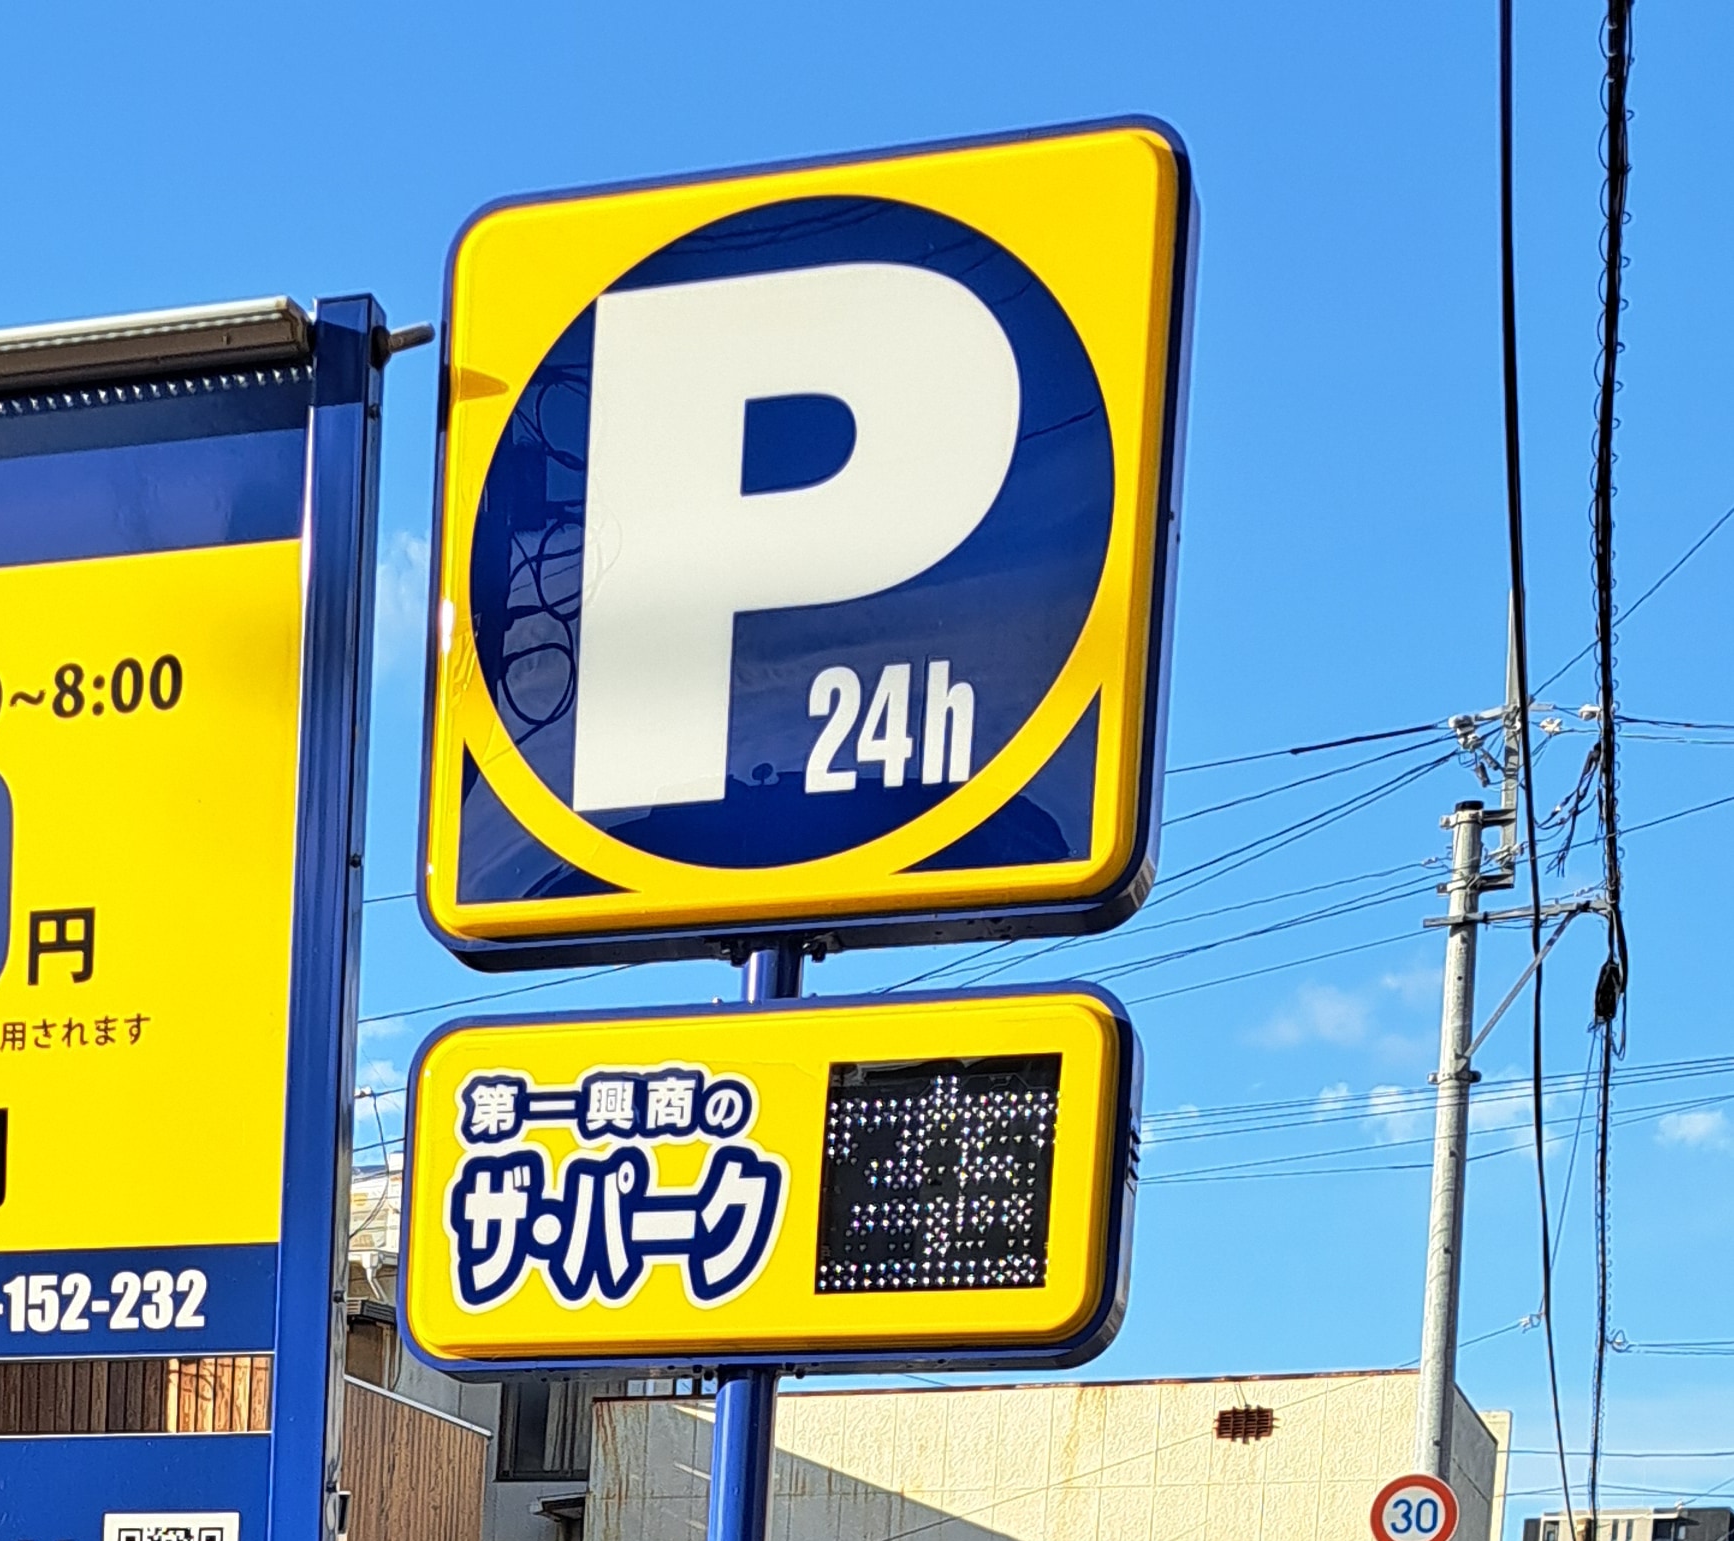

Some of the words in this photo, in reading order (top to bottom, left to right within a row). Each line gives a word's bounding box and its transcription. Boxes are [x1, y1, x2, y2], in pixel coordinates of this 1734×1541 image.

[573, 262, 1021, 812] P
[805, 660, 974, 794] 24h
[469, 1077, 744, 1137] 第一興商の
[465, 1163, 768, 1293] ザ・パーク
[1389, 1497, 1439, 1535] 30
